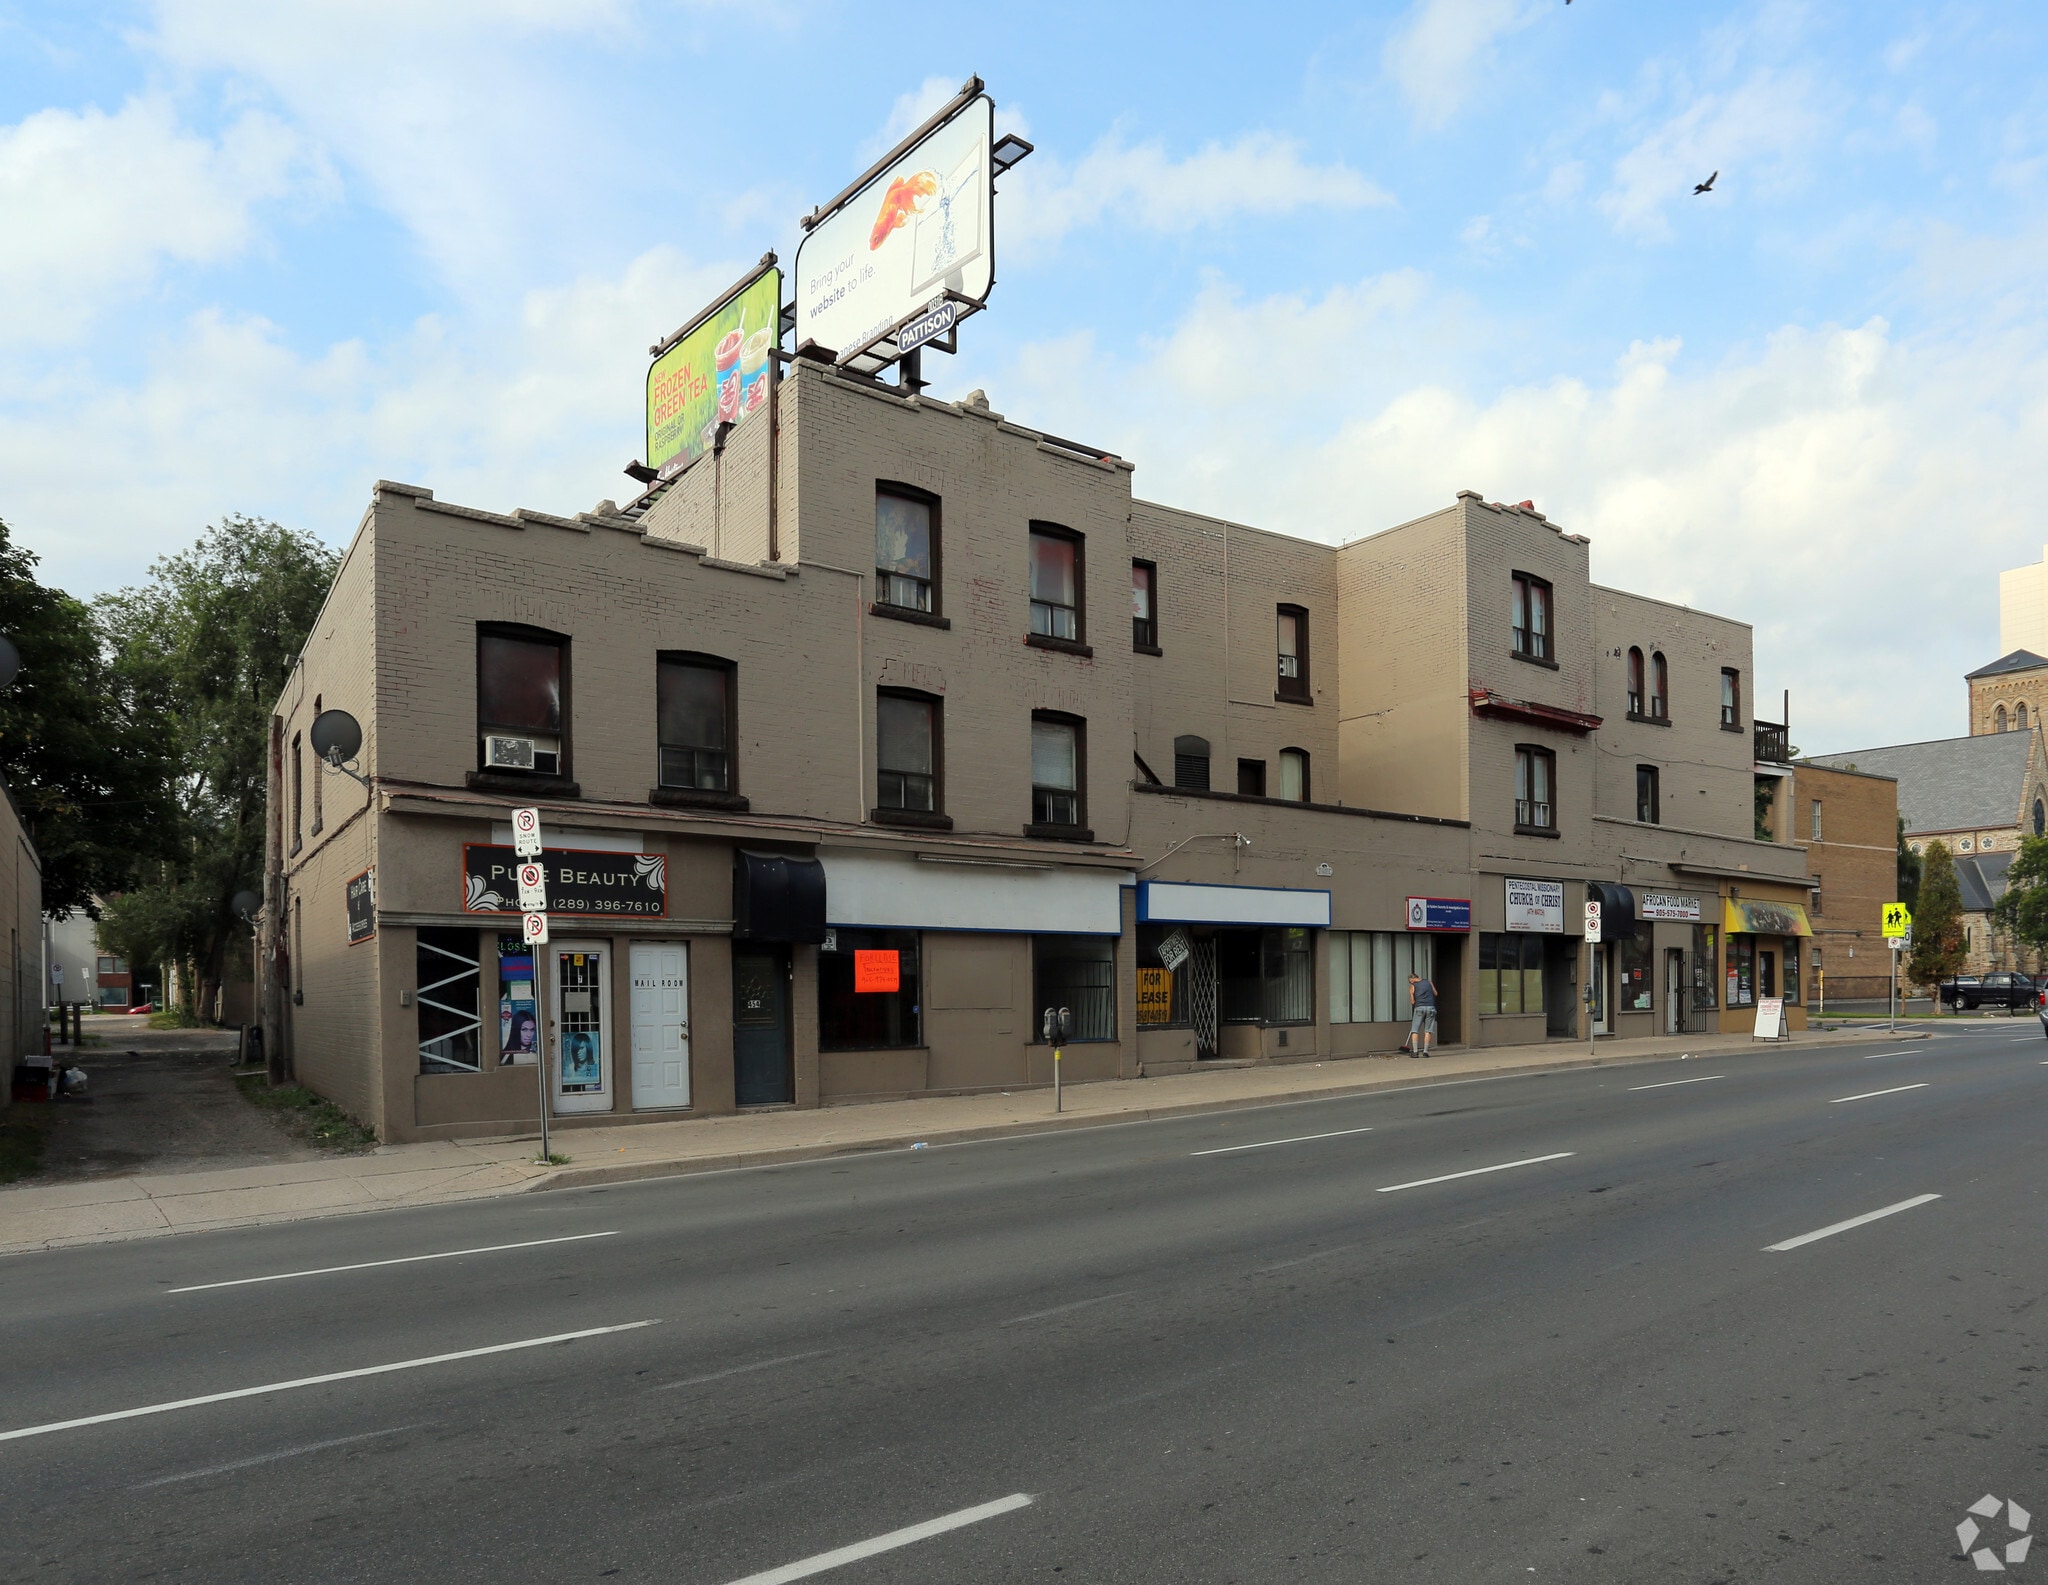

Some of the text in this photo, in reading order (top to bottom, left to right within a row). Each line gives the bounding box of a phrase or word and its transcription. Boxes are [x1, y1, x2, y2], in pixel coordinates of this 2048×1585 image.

[811, 253, 855, 295] Bring your
[810, 263, 876, 319] website to life.
[901, 307, 951, 348] PATTISON
[655, 362, 691, 406] FROZEN
[654, 373, 707, 427] GREEN TEA
[491, 865, 641, 887] PUE BEAUTY
[1509, 880, 1560, 893] PENTECOSTAL MISSIONARY
[553, 898, 590, 910] (289)
[595, 900, 660, 912] 396-7610
[1510, 892, 1533, 906] CHURCH
[1541, 894, 1560, 907] CHRIST
[1667, 896, 1680, 907] FOOD
[1681, 897, 1700, 909] MARKET
[1164, 950, 1176, 965] FOR
[1173, 939, 1187, 957] RENT
[662, 979, 683, 987] ROOM
[1143, 973, 1161, 986] FOR
